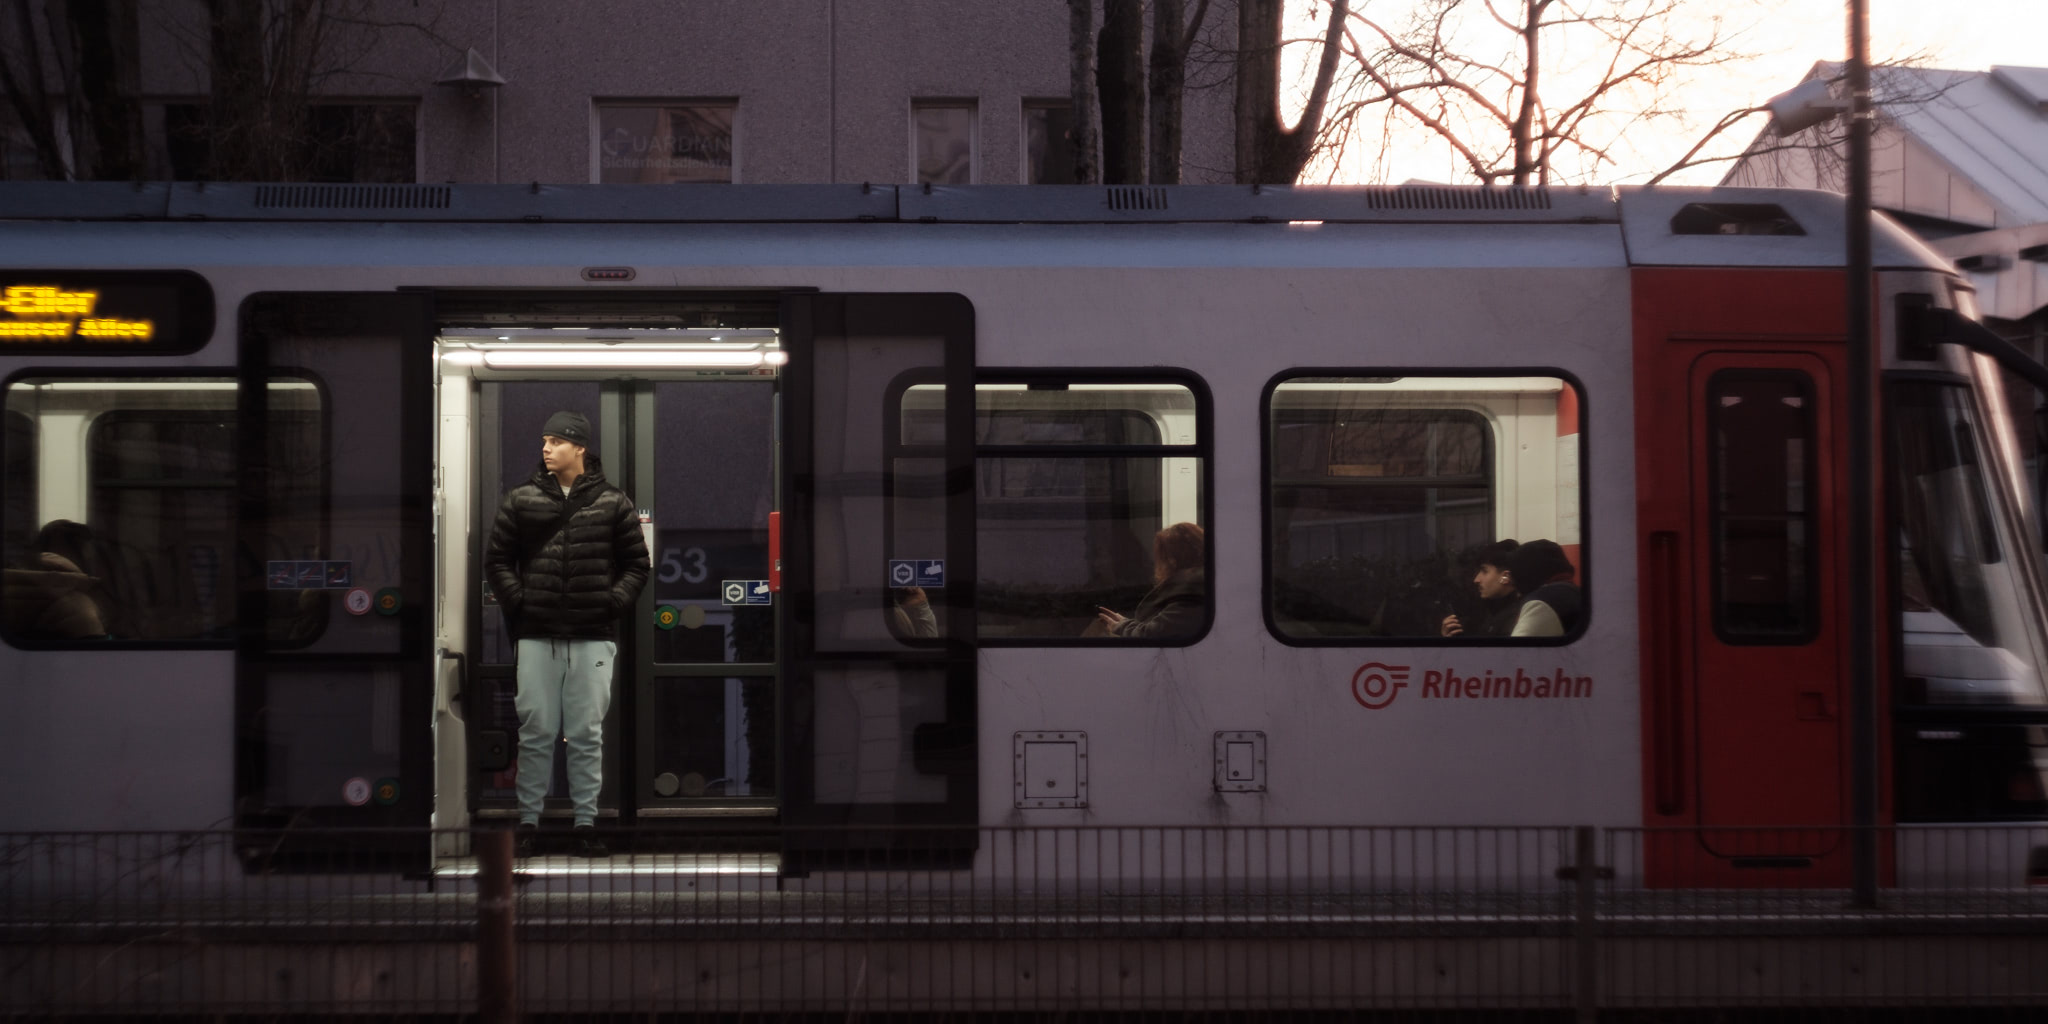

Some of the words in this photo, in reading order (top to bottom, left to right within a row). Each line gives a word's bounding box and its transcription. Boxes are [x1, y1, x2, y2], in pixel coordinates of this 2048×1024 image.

[77, 318, 150, 336] Allee
[658, 547, 707, 584] 53
[1421, 668, 1593, 699] Rheinbahn
